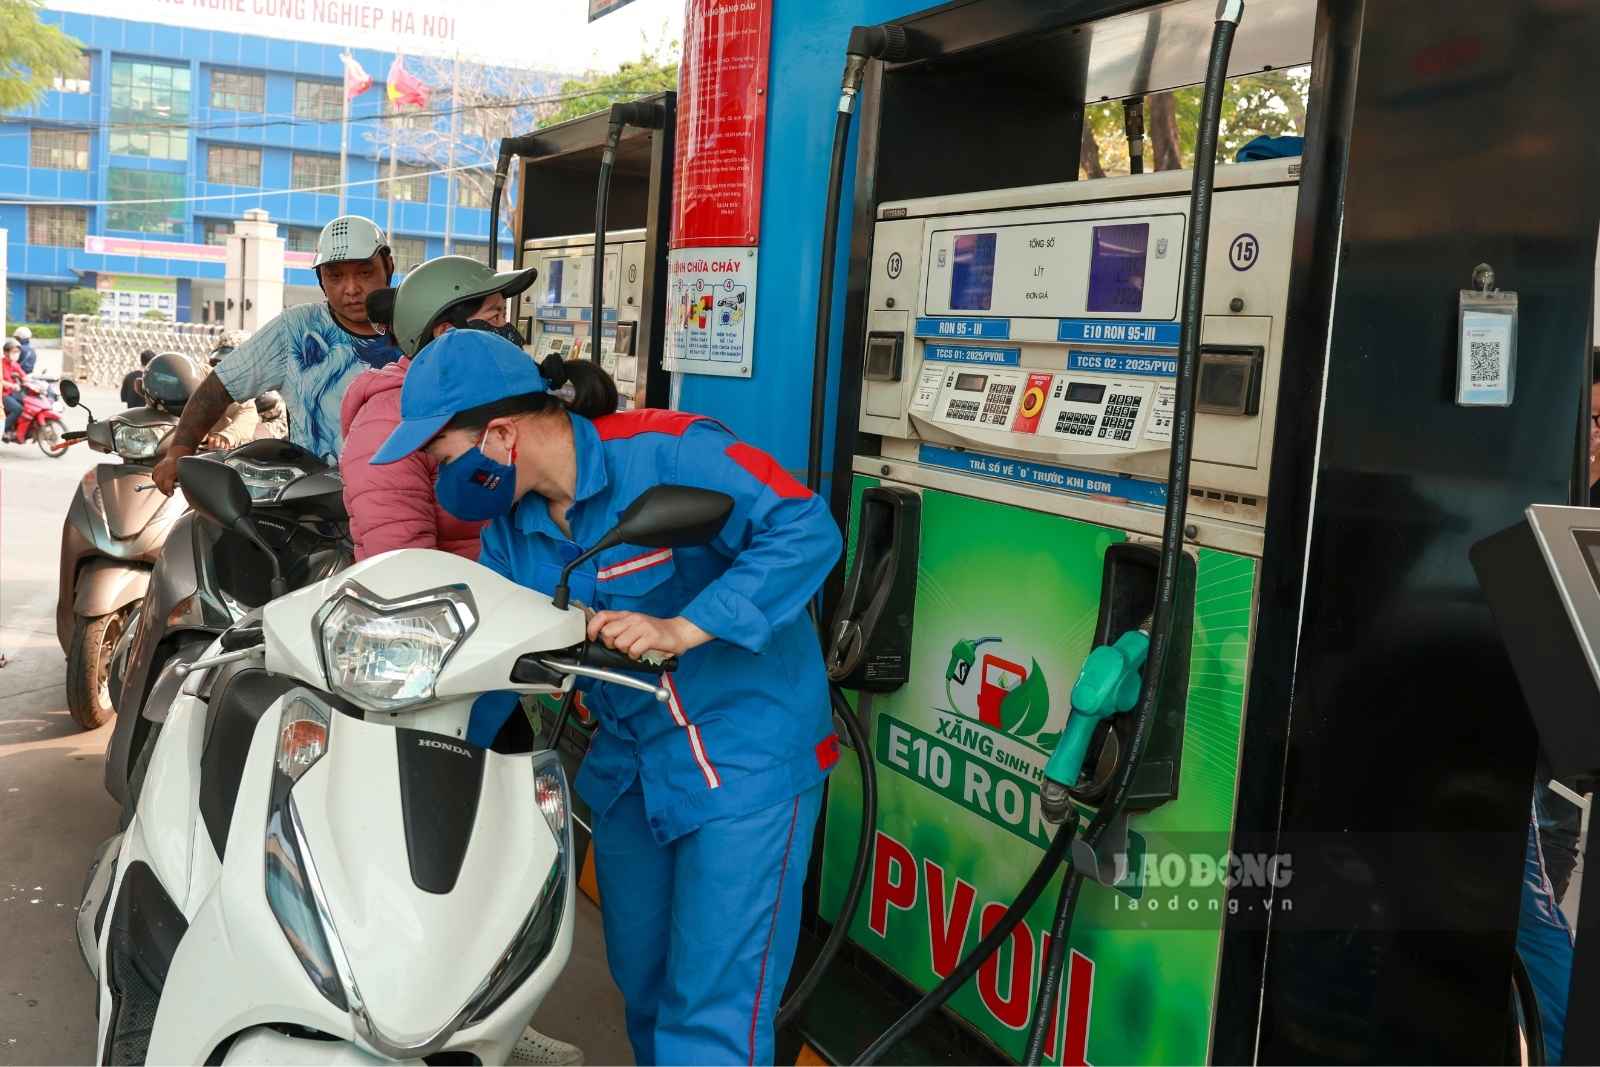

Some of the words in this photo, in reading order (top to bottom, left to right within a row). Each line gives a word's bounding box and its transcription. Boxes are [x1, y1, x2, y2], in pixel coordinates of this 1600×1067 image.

[1235, 241, 1254, 262] 15
[890, 258, 900, 273] 13
[939, 322, 955, 334] RON
[957, 322, 967, 335] 95
[1083, 324, 1102, 339] E10
[1103, 325, 1126, 340] RON
[1127, 326, 1156, 341] 95-III
[936, 348, 953, 359] TCCS
[1077, 356, 1102, 368] TCCS
[1103, 357, 1117, 369] 02
[1066, 475, 1084, 488] KHI
[418, 738, 473, 759] HONDA
[935, 716, 994, 758] XĂNG
[995, 749, 1030, 775] SINH
[888, 724, 952, 789] E10
